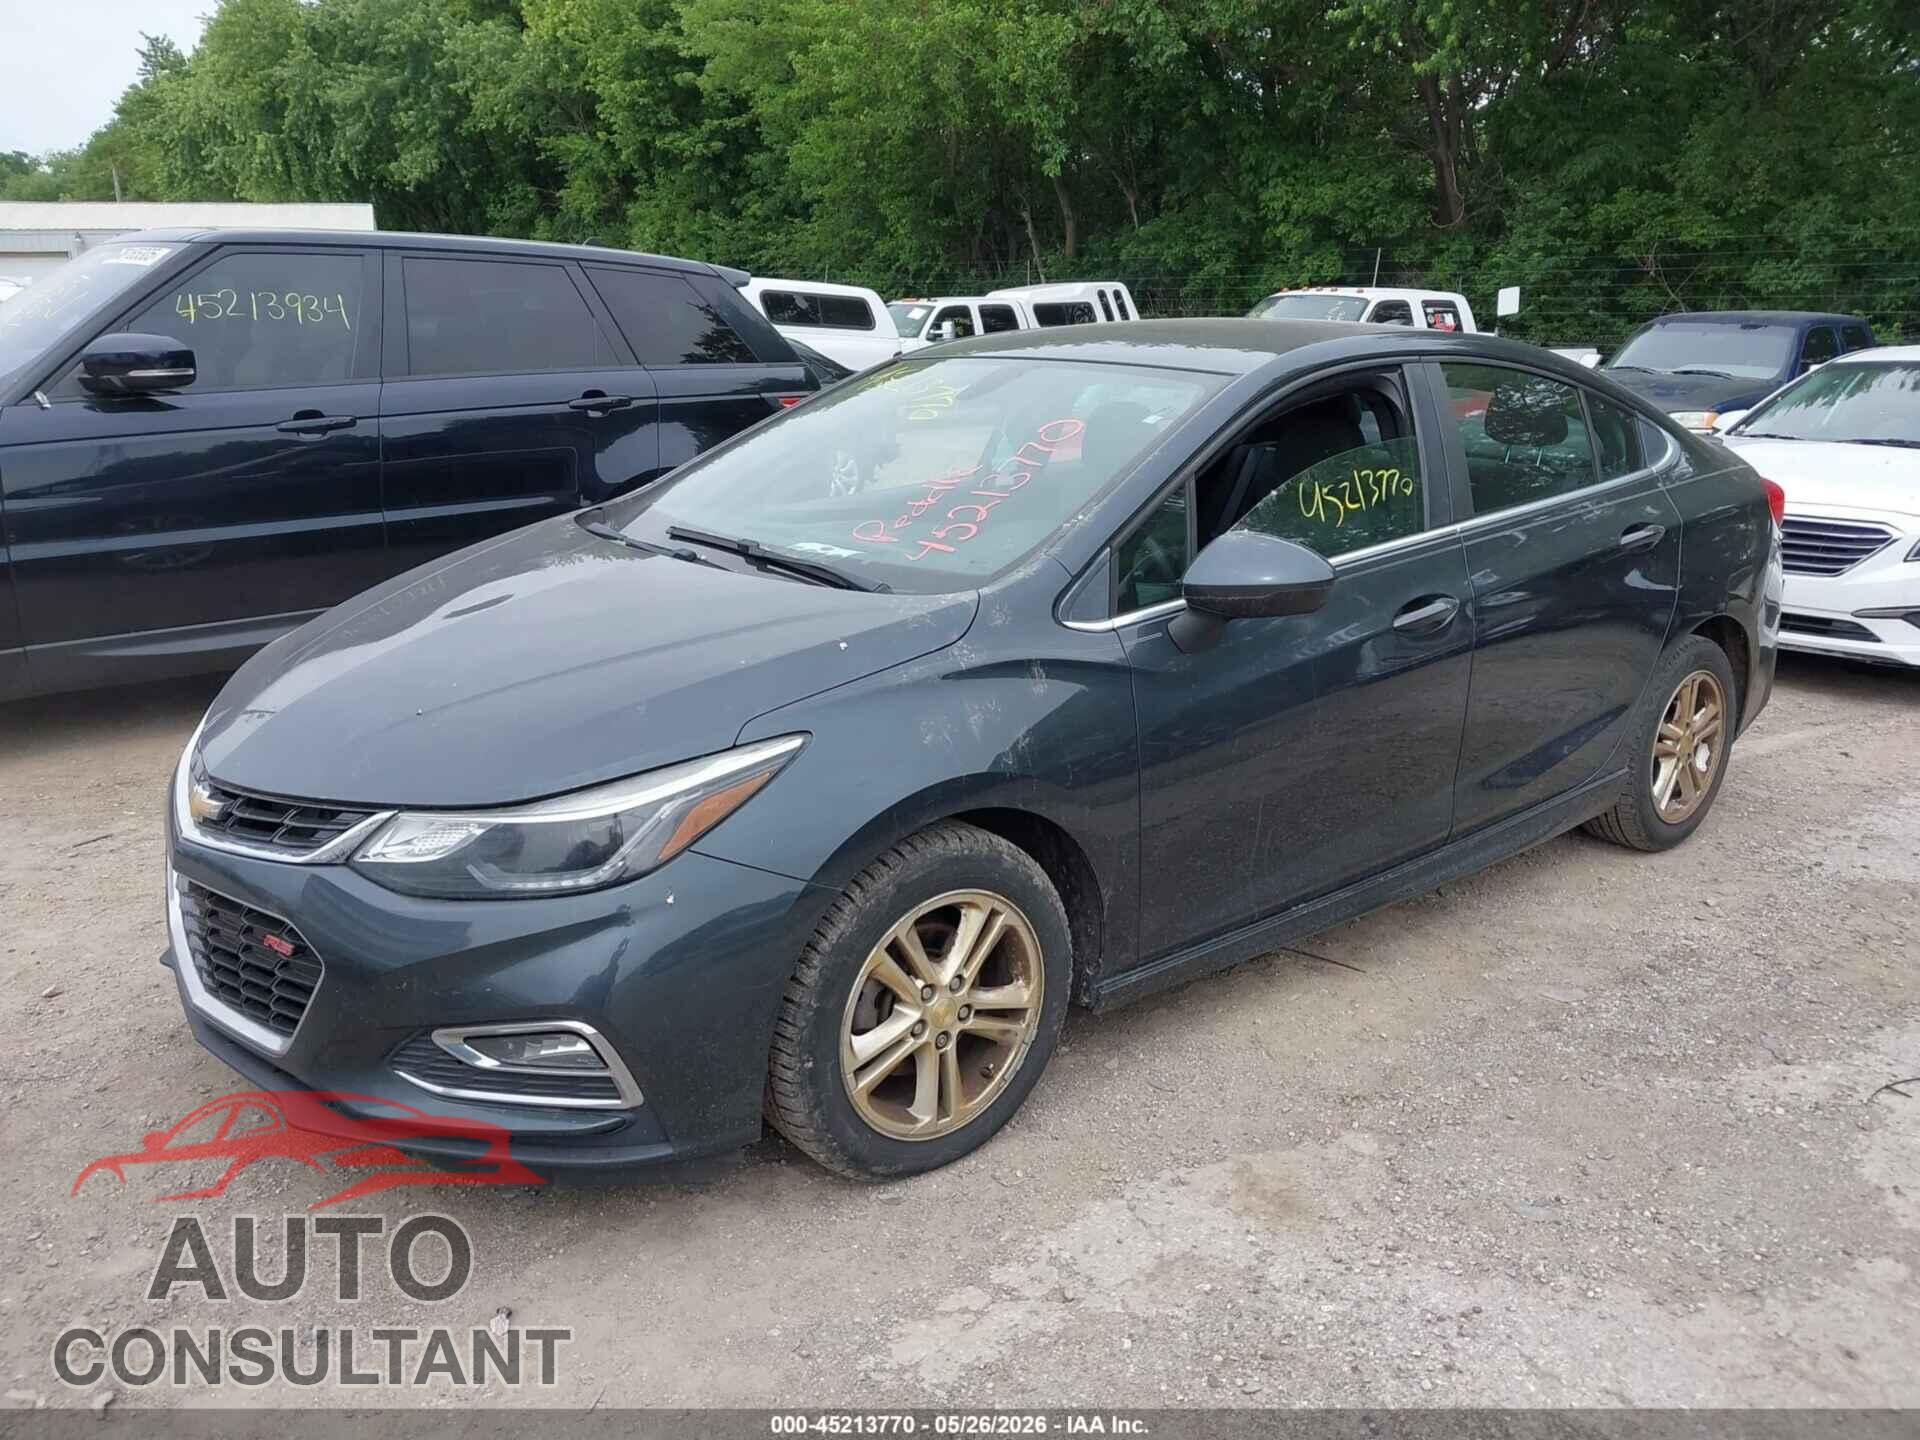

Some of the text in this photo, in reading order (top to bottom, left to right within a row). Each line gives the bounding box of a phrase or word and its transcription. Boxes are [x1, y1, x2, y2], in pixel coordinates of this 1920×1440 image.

[175, 288, 352, 330] 45213934
[902, 418, 1086, 561] 45213770
[1298, 468, 1414, 528] 45213770
